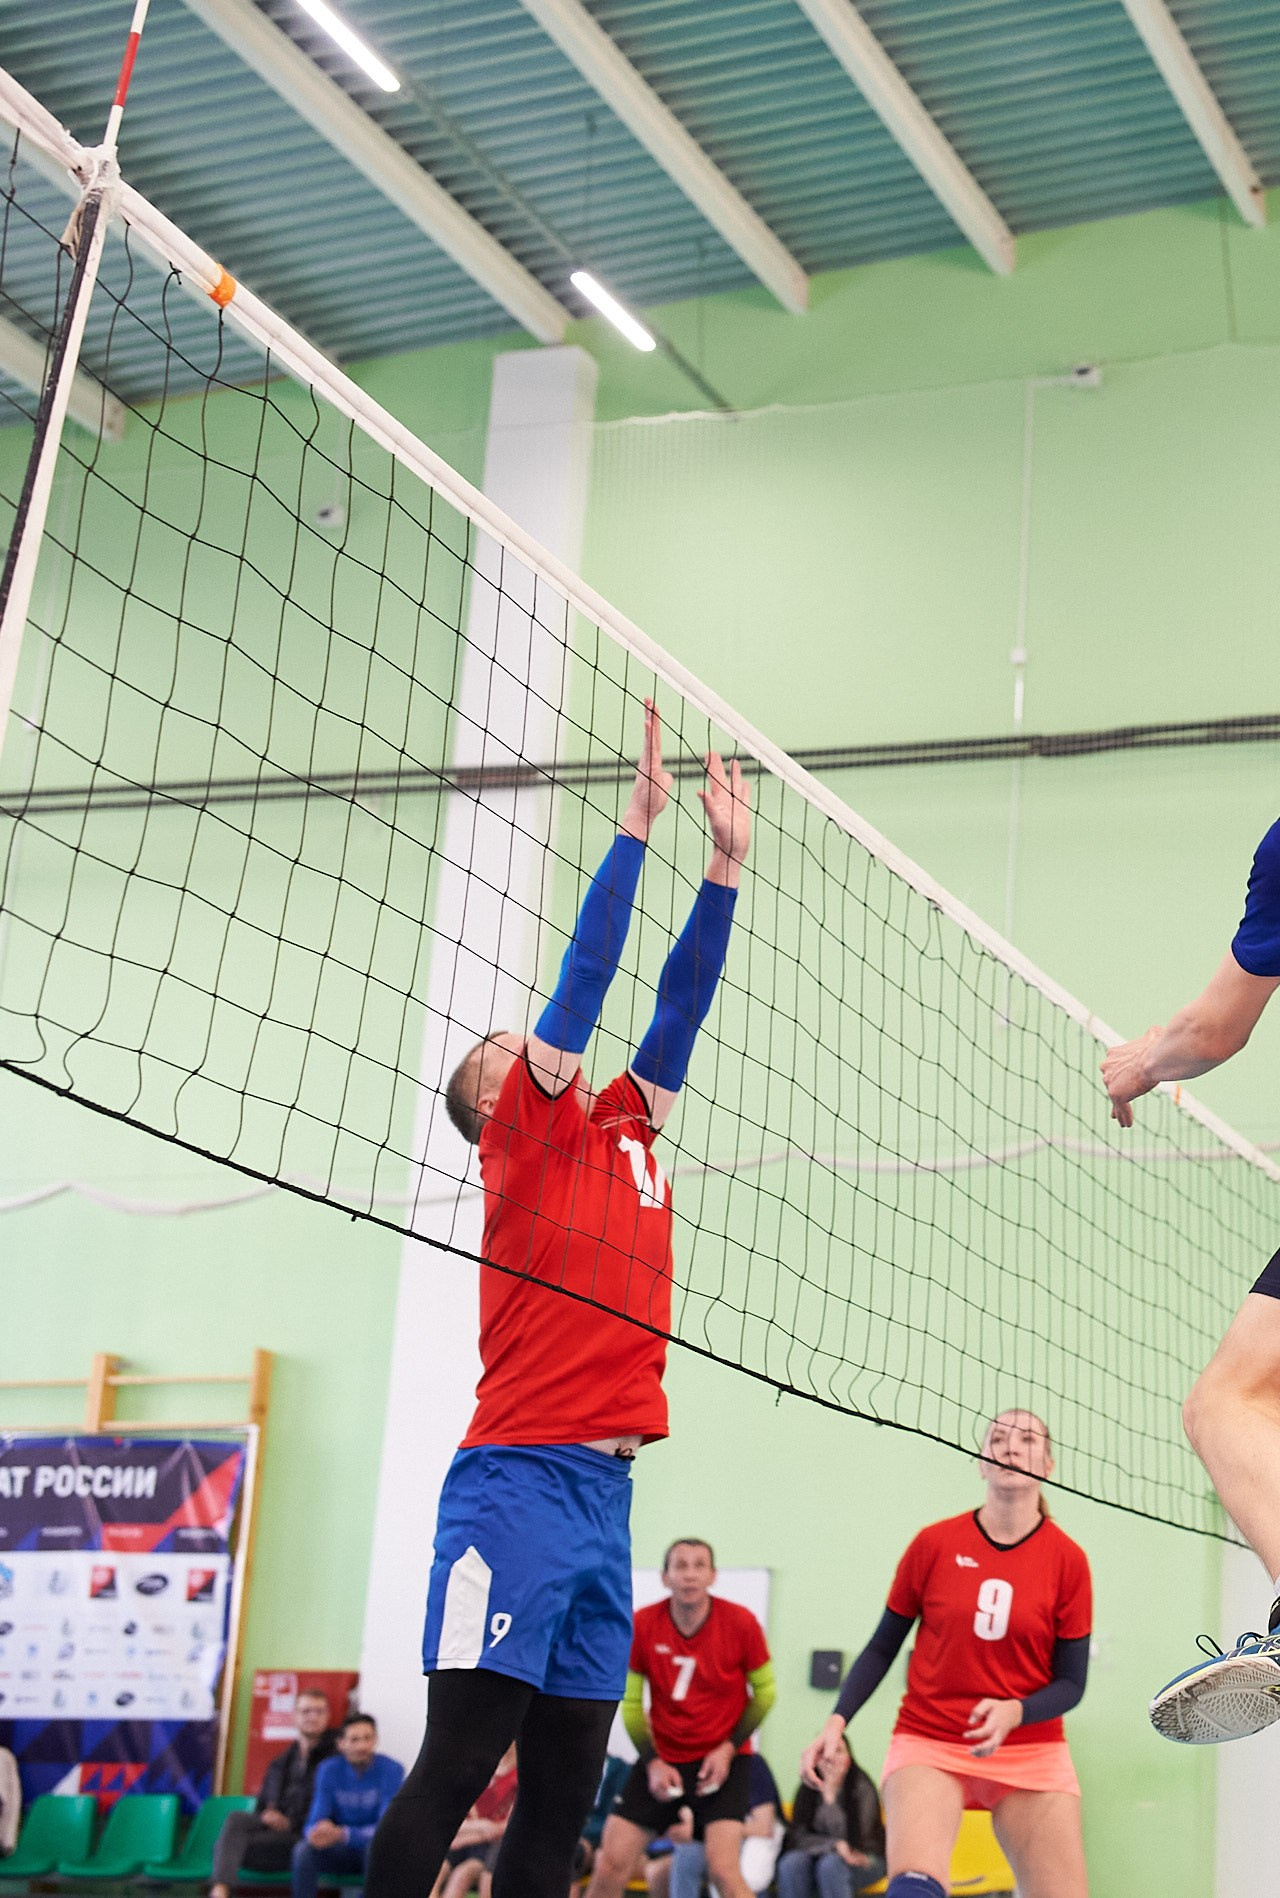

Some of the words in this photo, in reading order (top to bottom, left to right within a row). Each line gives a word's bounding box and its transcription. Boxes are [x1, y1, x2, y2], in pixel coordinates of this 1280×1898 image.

[34, 1464, 158, 1499] РОССИИ
[489, 1612, 513, 1648] 9
[973, 1578, 1014, 1641] 9
[671, 1655, 697, 1701] 7
